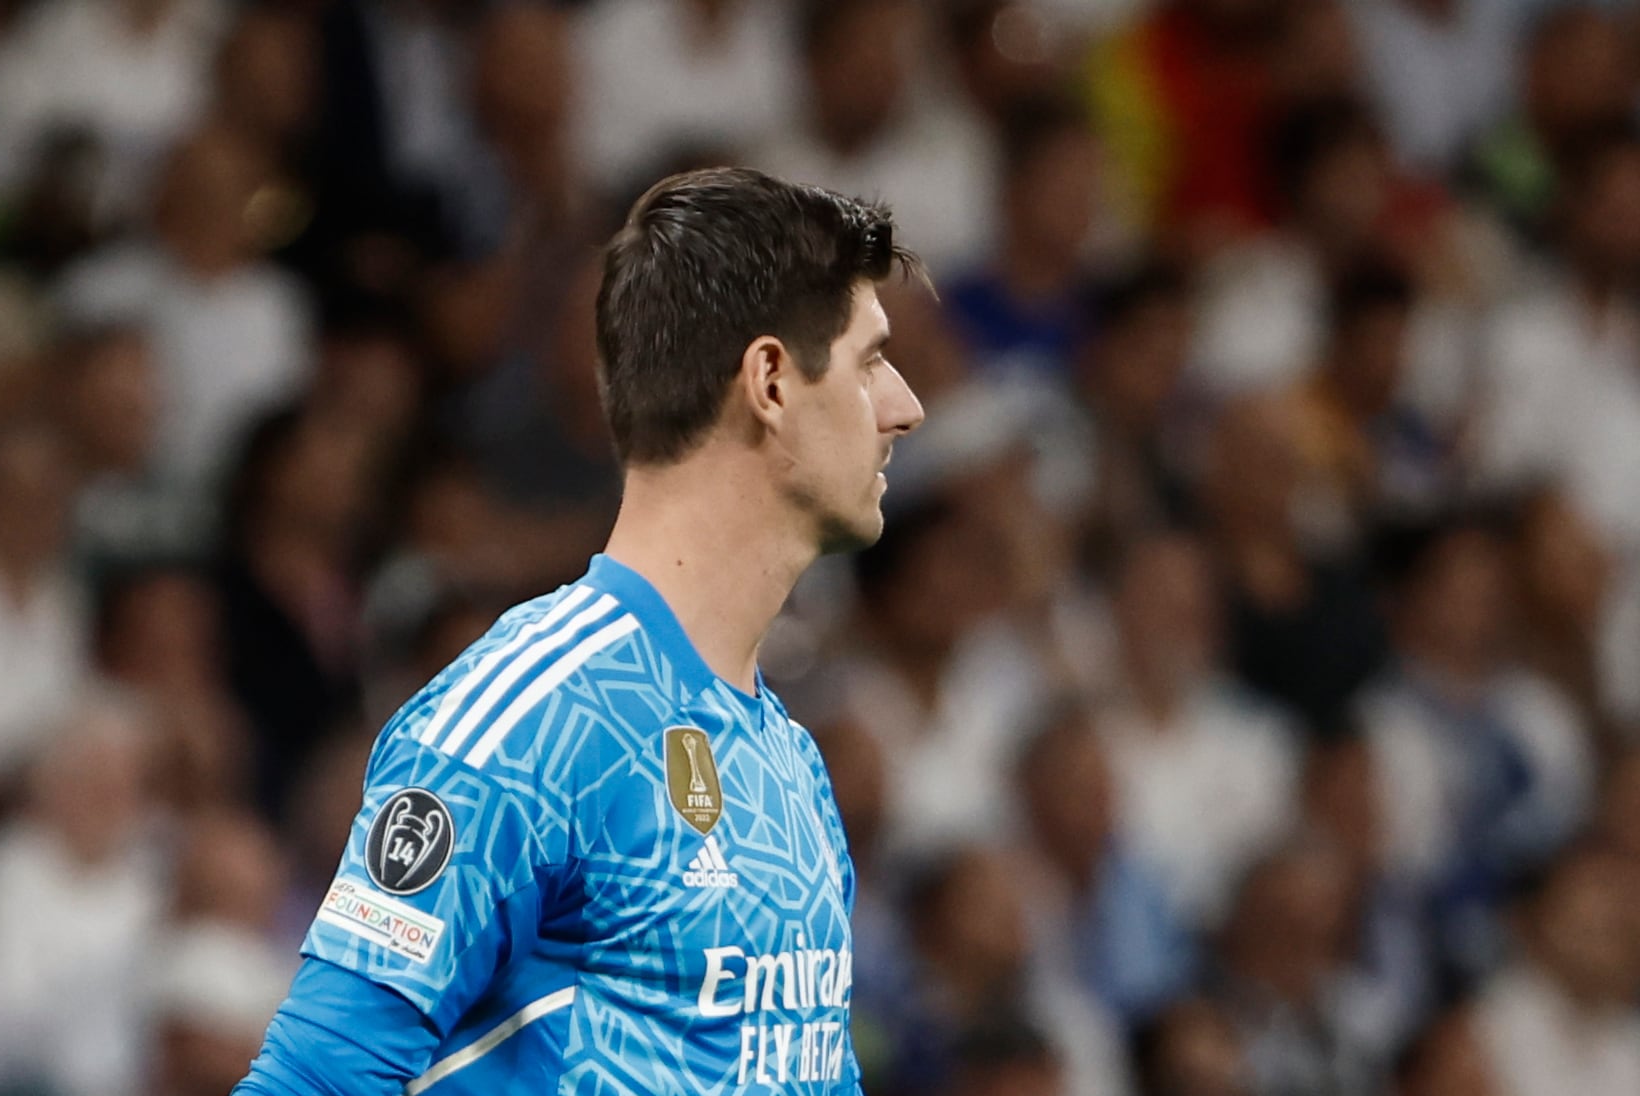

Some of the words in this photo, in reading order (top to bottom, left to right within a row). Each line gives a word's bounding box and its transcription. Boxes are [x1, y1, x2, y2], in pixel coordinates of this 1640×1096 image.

[687, 794, 713, 808] FIFA
[388, 837, 415, 867] 14
[682, 870, 738, 888] adidas
[327, 892, 434, 949] FOUNDATION
[737, 1023, 796, 1085] FLY
